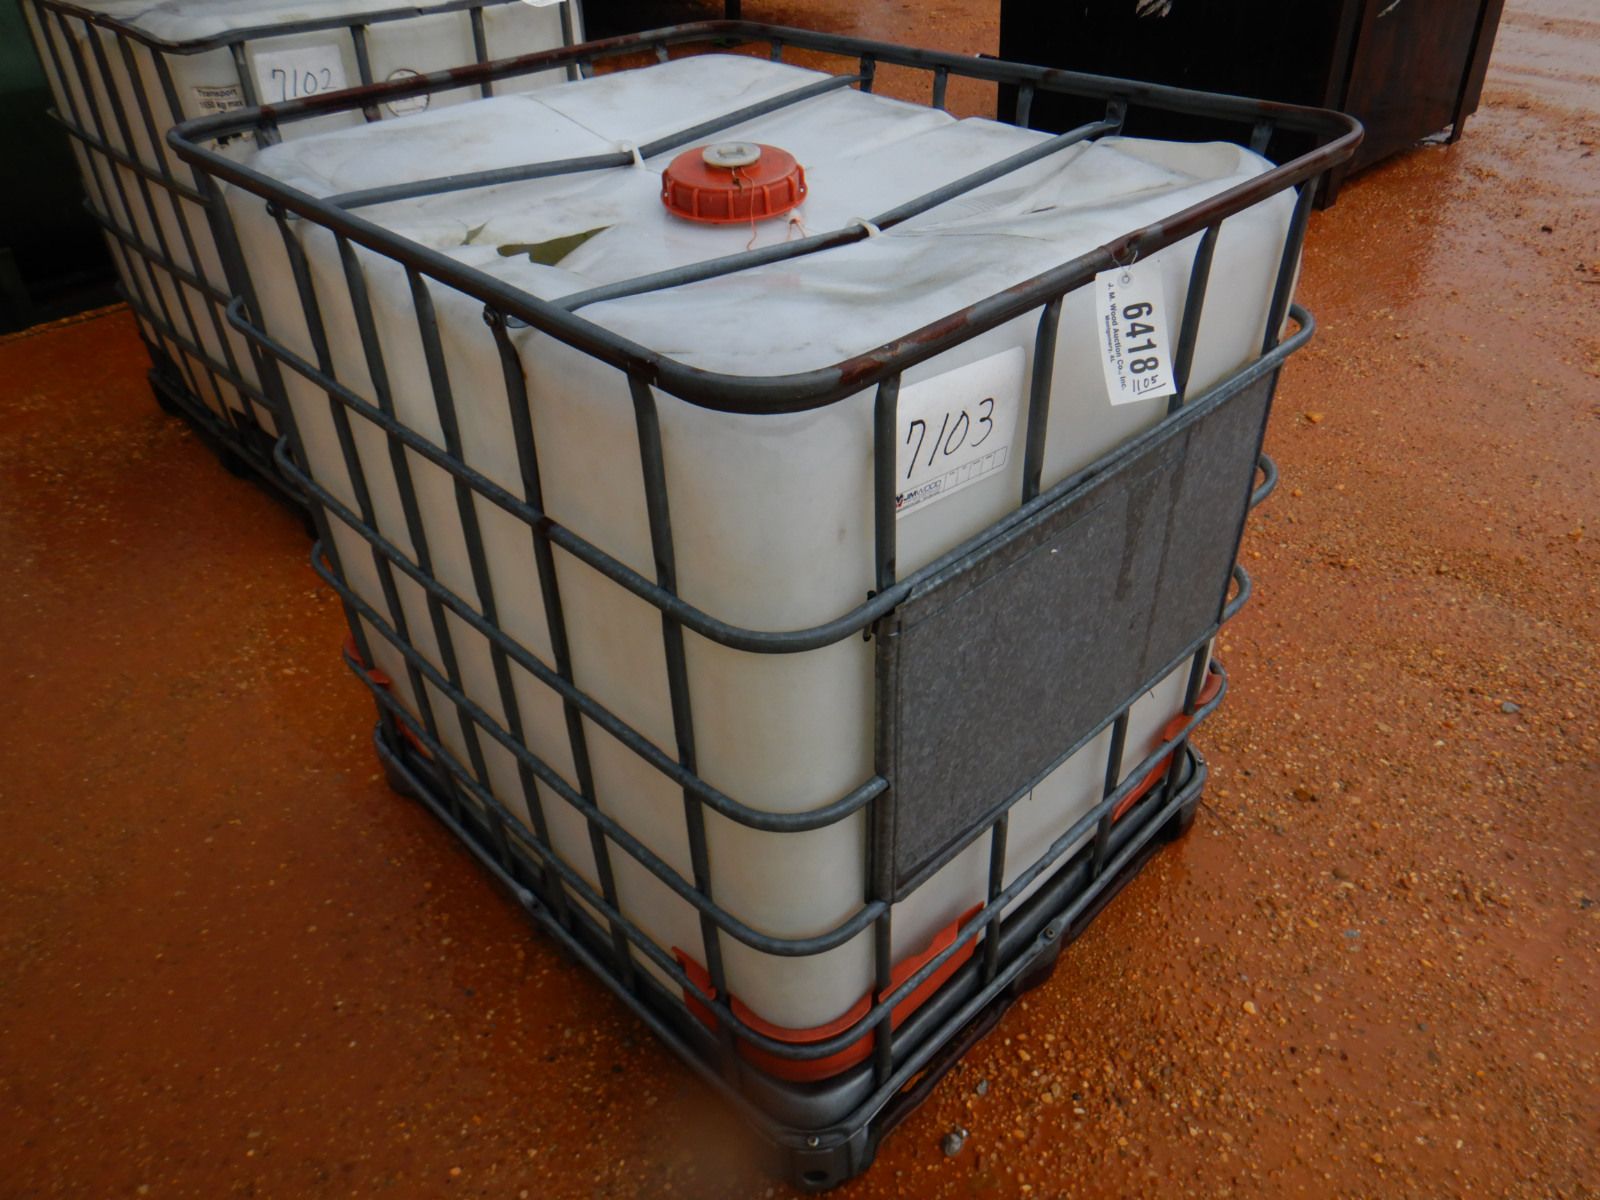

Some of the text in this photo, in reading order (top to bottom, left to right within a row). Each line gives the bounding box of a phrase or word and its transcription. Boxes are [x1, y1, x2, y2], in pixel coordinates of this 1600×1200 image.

[197, 88, 237, 98] Transport
[271, 67, 336, 101] 7102
[1110, 303, 1118, 326] Wood
[1112, 328, 1121, 358] Auction
[1122, 302, 1159, 375] 6418
[1120, 376, 1128, 392] Inc.
[906, 397, 995, 479] 7103
